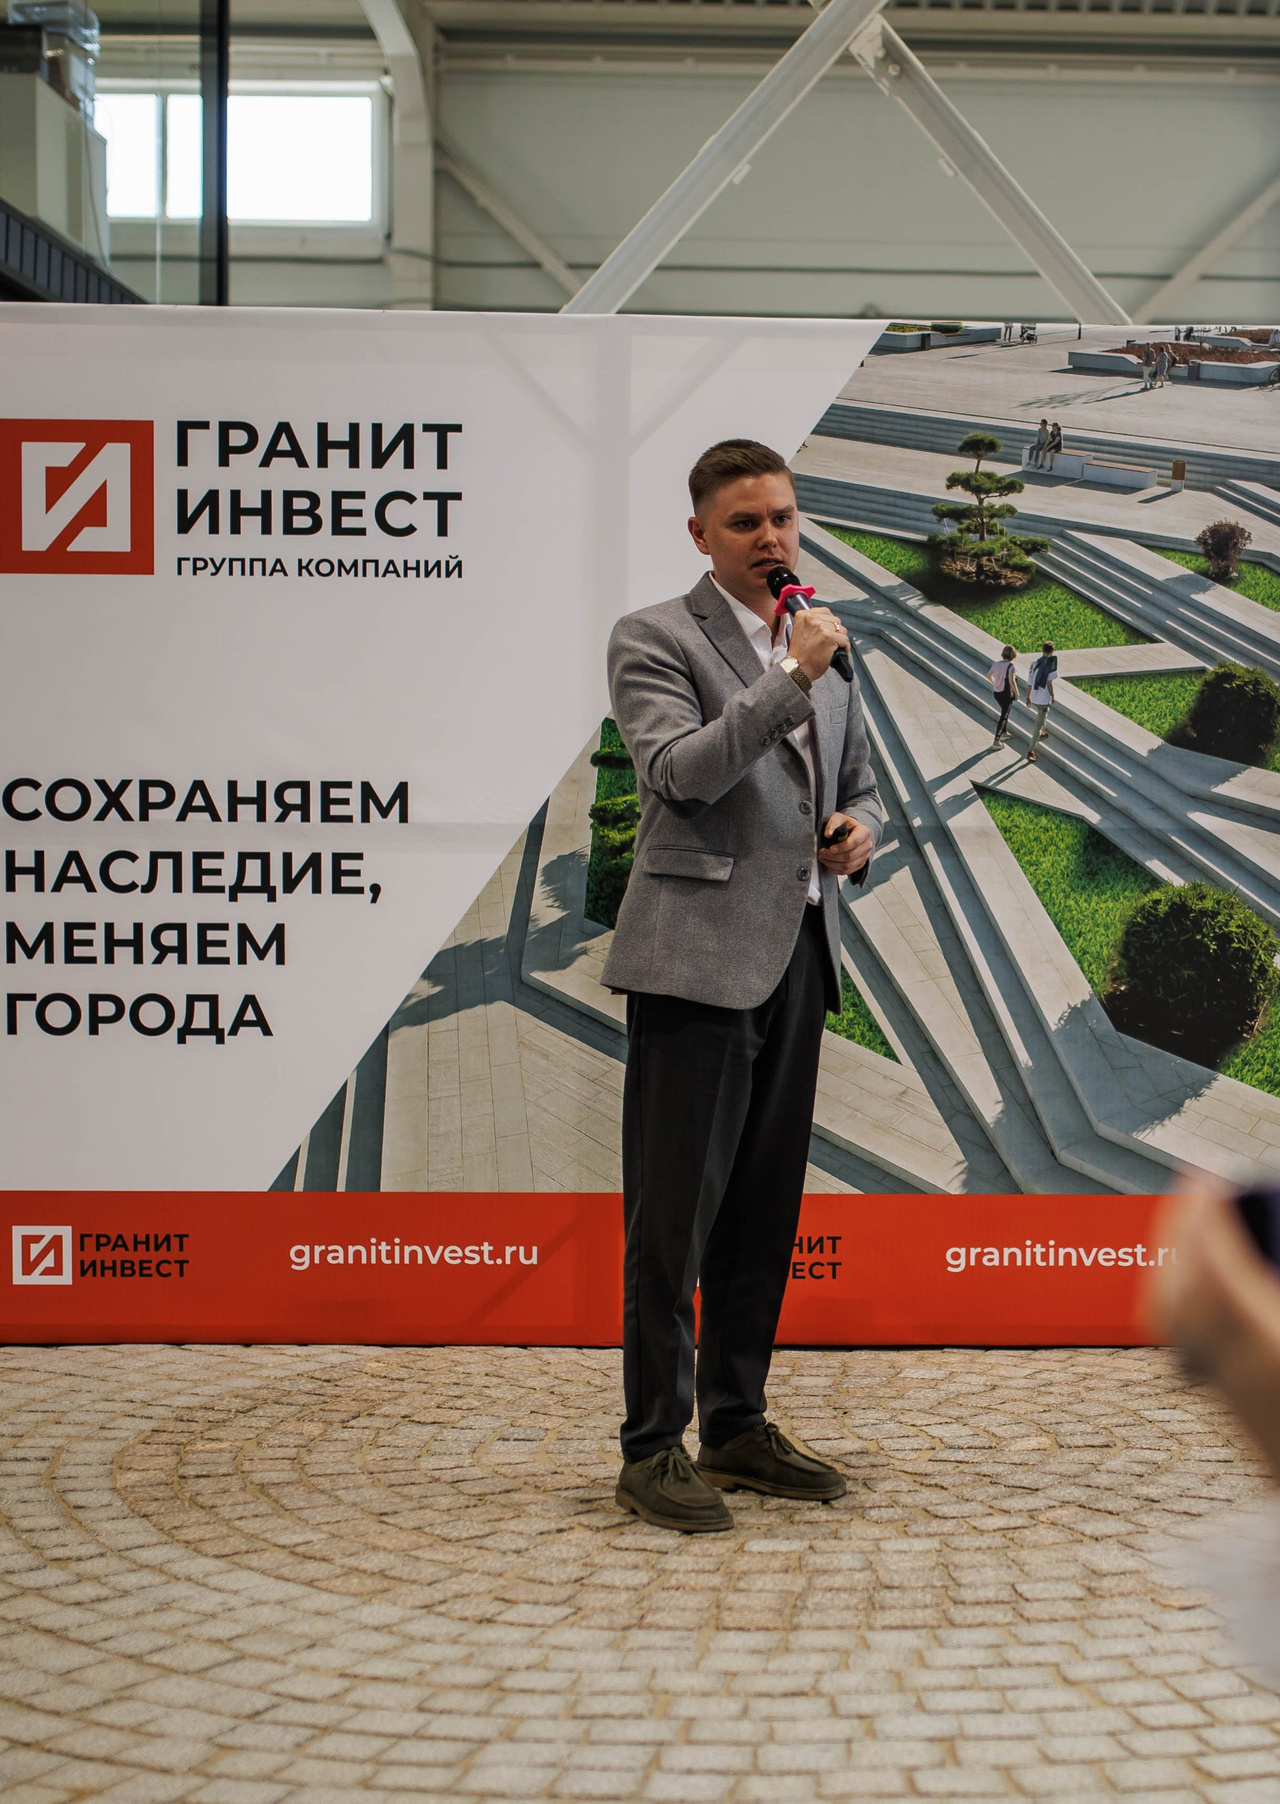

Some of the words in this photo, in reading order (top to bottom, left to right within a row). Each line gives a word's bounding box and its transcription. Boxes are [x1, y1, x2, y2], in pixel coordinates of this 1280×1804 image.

[177, 420, 463, 470] ГРАНИТ
[177, 489, 463, 538] ИНВЕСТ
[176, 557, 288, 577] ГРУППА
[297, 555, 463, 579] КОМПАНИЙ
[2, 777, 409, 824] СОХРАНЯЕМ
[4, 849, 382, 904] НАСЛЕДИЕ,
[5, 921, 286, 966] МЕНЯЕМ
[6, 993, 273, 1045] ГОРОДА
[80, 1233, 189, 1253] ГРАНИТ
[290, 1238, 538, 1270] granitinvest.ru
[792, 1236, 842, 1255] НИТ
[80, 1259, 189, 1278] ИНВЕСТ
[791, 1261, 842, 1280] ЕСТ
